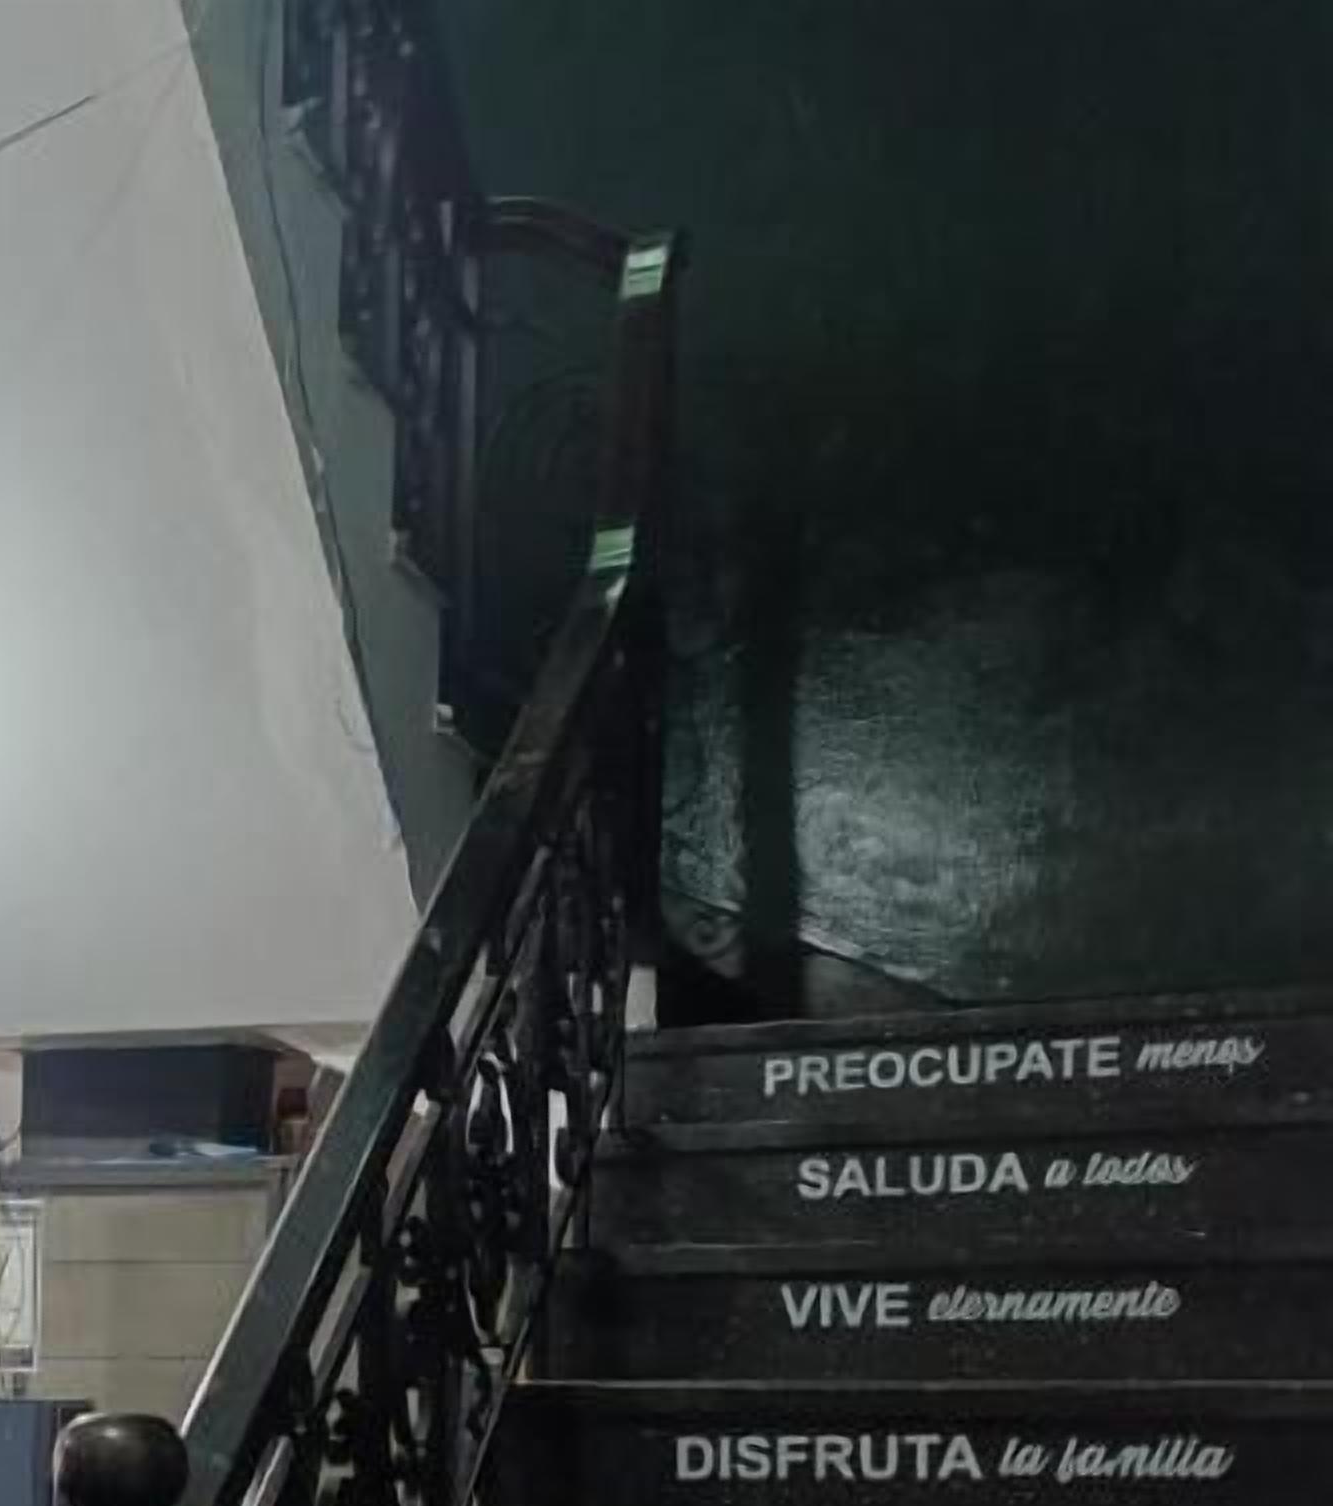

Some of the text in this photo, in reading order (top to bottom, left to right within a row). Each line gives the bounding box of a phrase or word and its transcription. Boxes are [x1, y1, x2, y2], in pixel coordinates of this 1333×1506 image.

[763, 1034, 1266, 1097] PREOCUPATE menos
[796, 1150, 1199, 1200] SALUDA a todos
[779, 1280, 1183, 1329] VIVE eternamente
[675, 1433, 1235, 1484] DISFRUTA la familia
